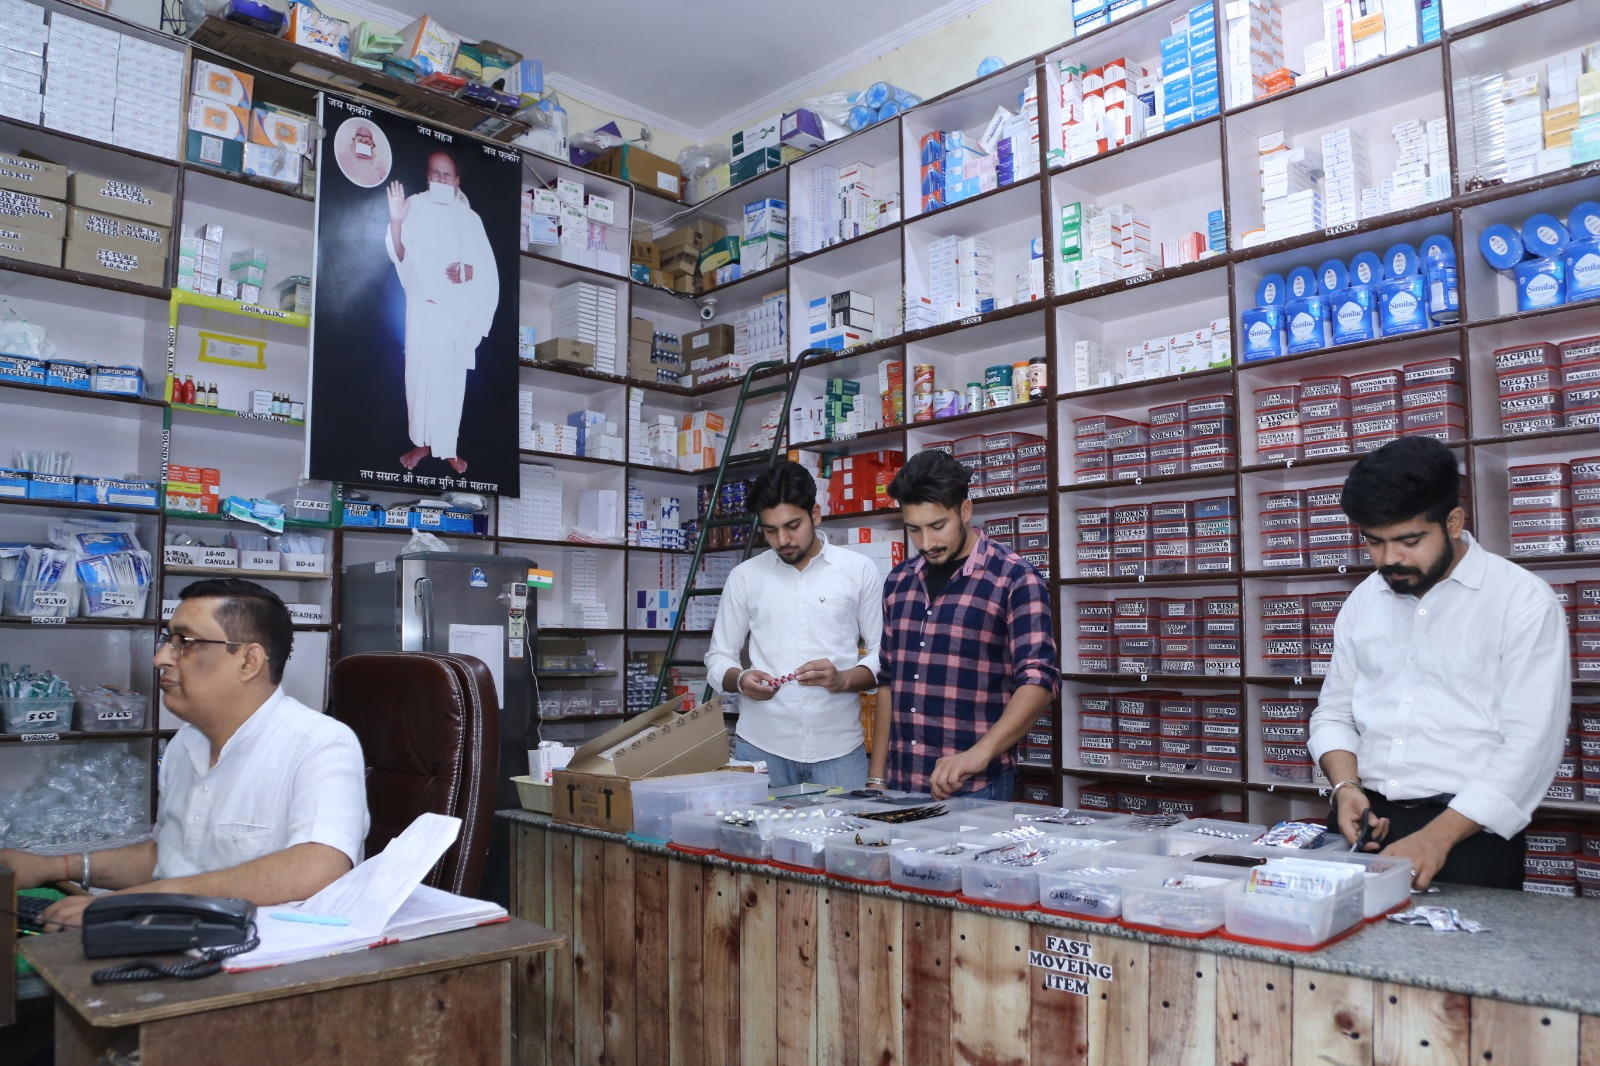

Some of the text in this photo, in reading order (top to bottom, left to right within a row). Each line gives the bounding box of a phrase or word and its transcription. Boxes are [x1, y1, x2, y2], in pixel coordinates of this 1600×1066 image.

[327, 96, 343, 110] जय
[417, 124, 453, 144] जय सहज
[482, 145, 497, 157] जय
[16, 172, 32, 181] KIT
[108, 180, 142, 193] CUFFED
[87, 220, 118, 232] WATER
[89, 214, 119, 227] UNDER
[85, 225, 119, 238] SEALED
[1326, 222, 1358, 235] STOCK
[120, 229, 161, 244] CHAMBER
[1574, 262, 1600, 275] Simila
[1126, 273, 1152, 285] STOCK
[1527, 283, 1558, 293] Similac
[240, 304, 286, 318] LOOK ALIKE
[1389, 300, 1417, 310] Similac
[1338, 310, 1362, 320] Similac
[1291, 320, 1314, 331] Similac
[167, 326, 175, 349] LOOK
[1249, 329, 1271, 337] Similac
[1495, 348, 1543, 363] MACPRIL
[98, 367, 137, 377] SURGICARE
[1501, 374, 1547, 387] MEGALIS
[54, 476, 73, 484] LINE
[360, 469, 498, 492] तप सम्राट श्री सहज मुनि जी महाराज
[1135, 477, 1142, 485] C
[204, 558, 236, 566] CANULLA
[1338, 565, 1347, 573] G
[1294, 677, 1302, 685] H
[37, 711, 55, 720] CC
[22, 733, 59, 742] SYRINGE
[1046, 936, 1092, 957] FAST
[1029, 951, 1112, 980] MOVEING
[1046, 973, 1089, 995] ITEM
